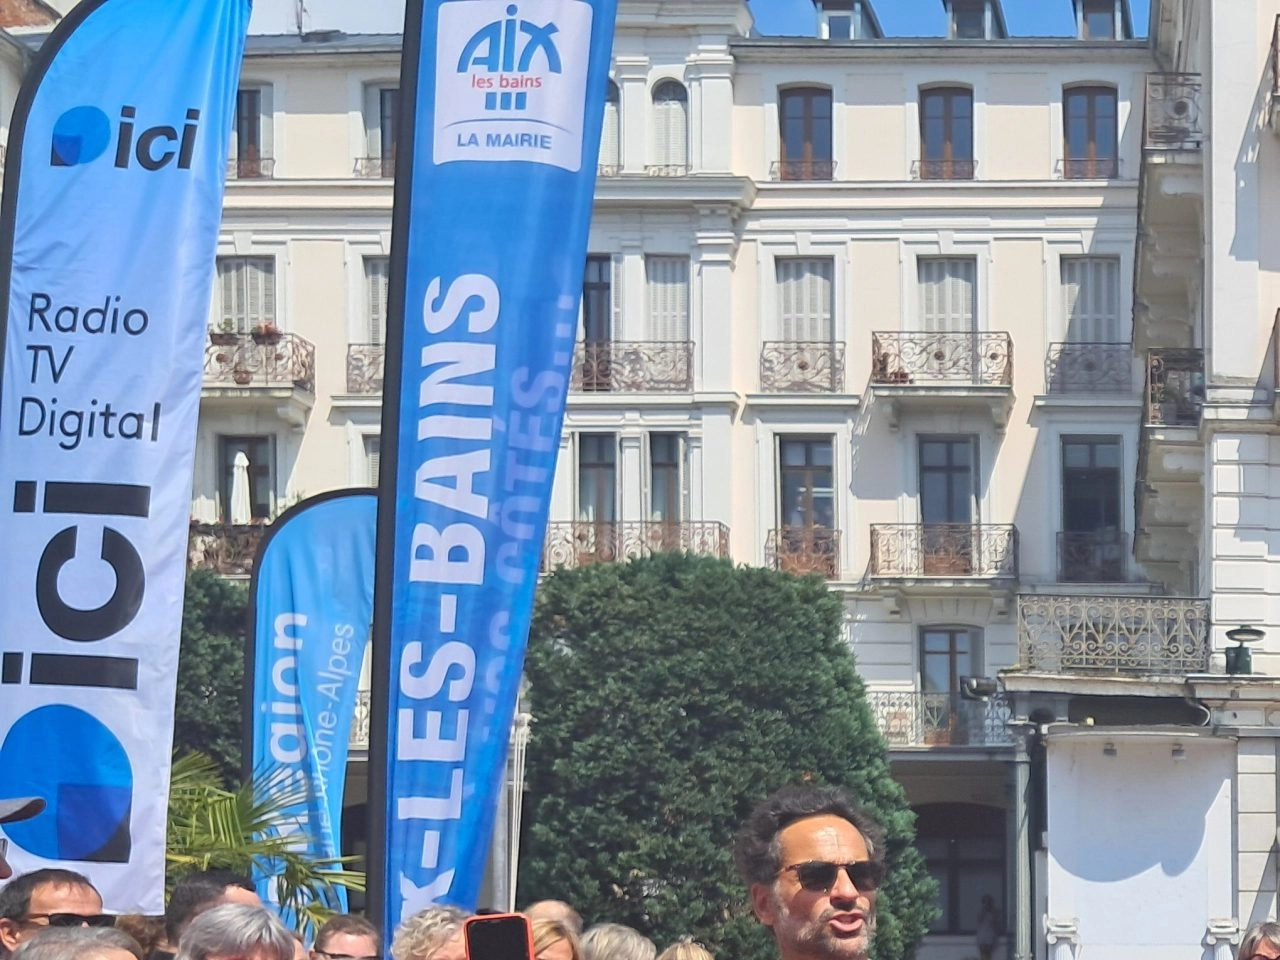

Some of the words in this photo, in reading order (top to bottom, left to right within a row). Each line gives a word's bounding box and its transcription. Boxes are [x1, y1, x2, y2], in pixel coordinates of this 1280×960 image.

[471, 74, 493, 88] les
[499, 74, 542, 88] bains
[114, 106, 199, 170] ici
[457, 133, 479, 147] LA
[486, 133, 552, 149] MAIRIE
[27, 292, 149, 336] Radio
[28, 344, 74, 384] TV
[18, 398, 161, 451] Digital
[2, 481, 151, 690] ici
